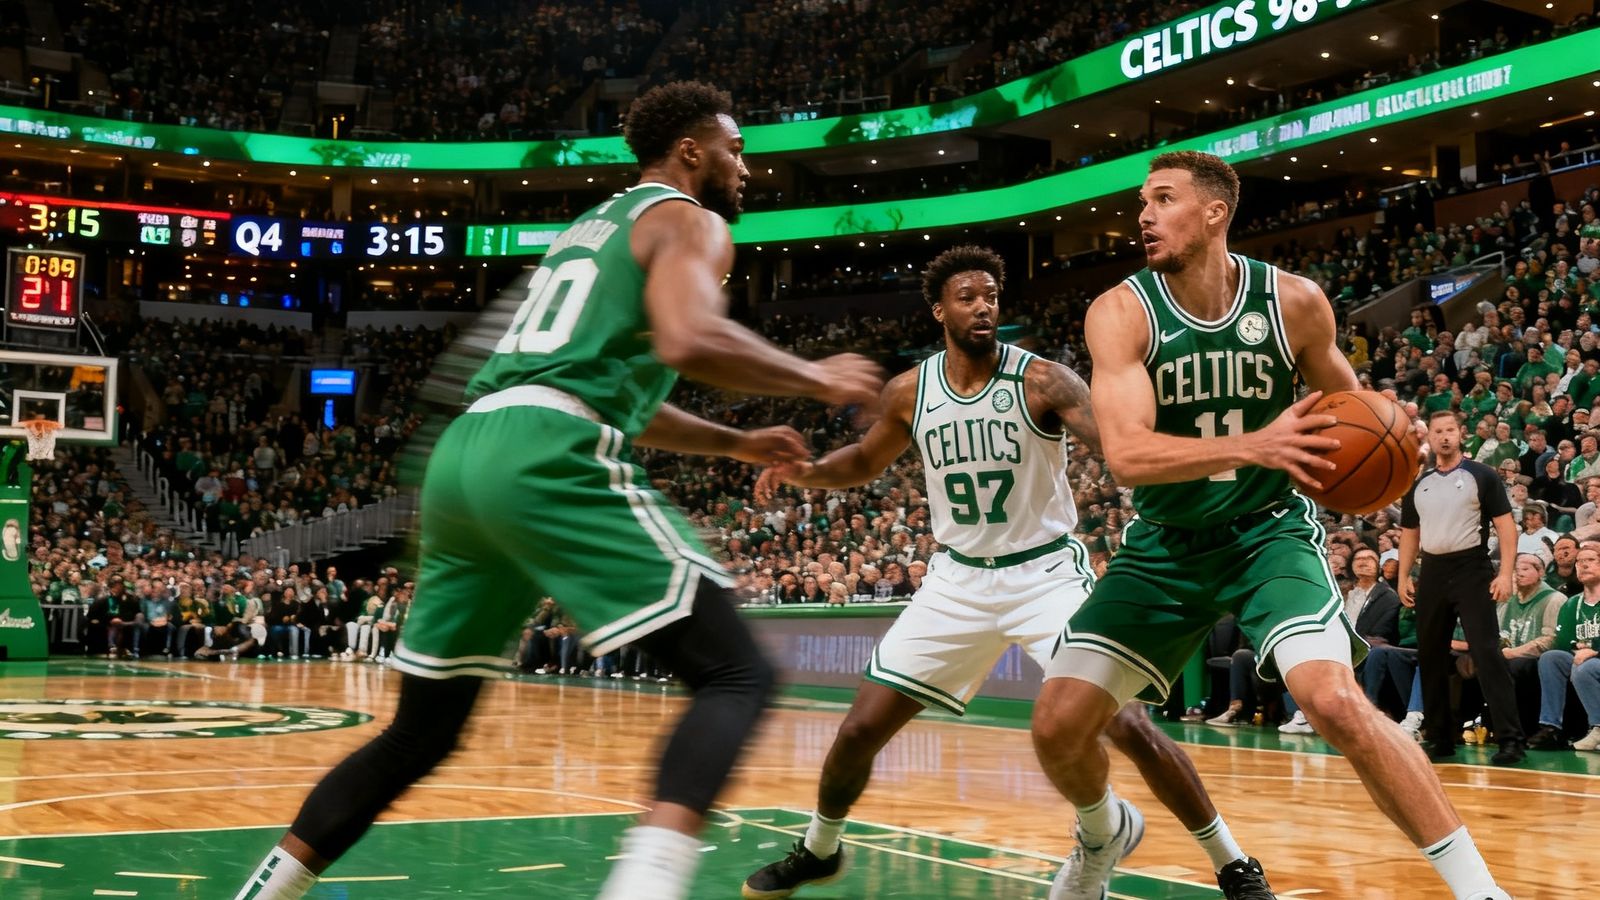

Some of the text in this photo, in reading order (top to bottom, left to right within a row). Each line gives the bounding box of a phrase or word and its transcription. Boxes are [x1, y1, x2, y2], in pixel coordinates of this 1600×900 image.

[1120, 0, 1258, 79] CELTICS
[29, 204, 100, 237] 3:15
[235, 221, 283, 256] Q4
[366, 225, 445, 256] 3:15
[1156, 350, 1274, 406] CELTICS
[925, 418, 1021, 470] CELTICS
[944, 469, 1015, 525] 97
